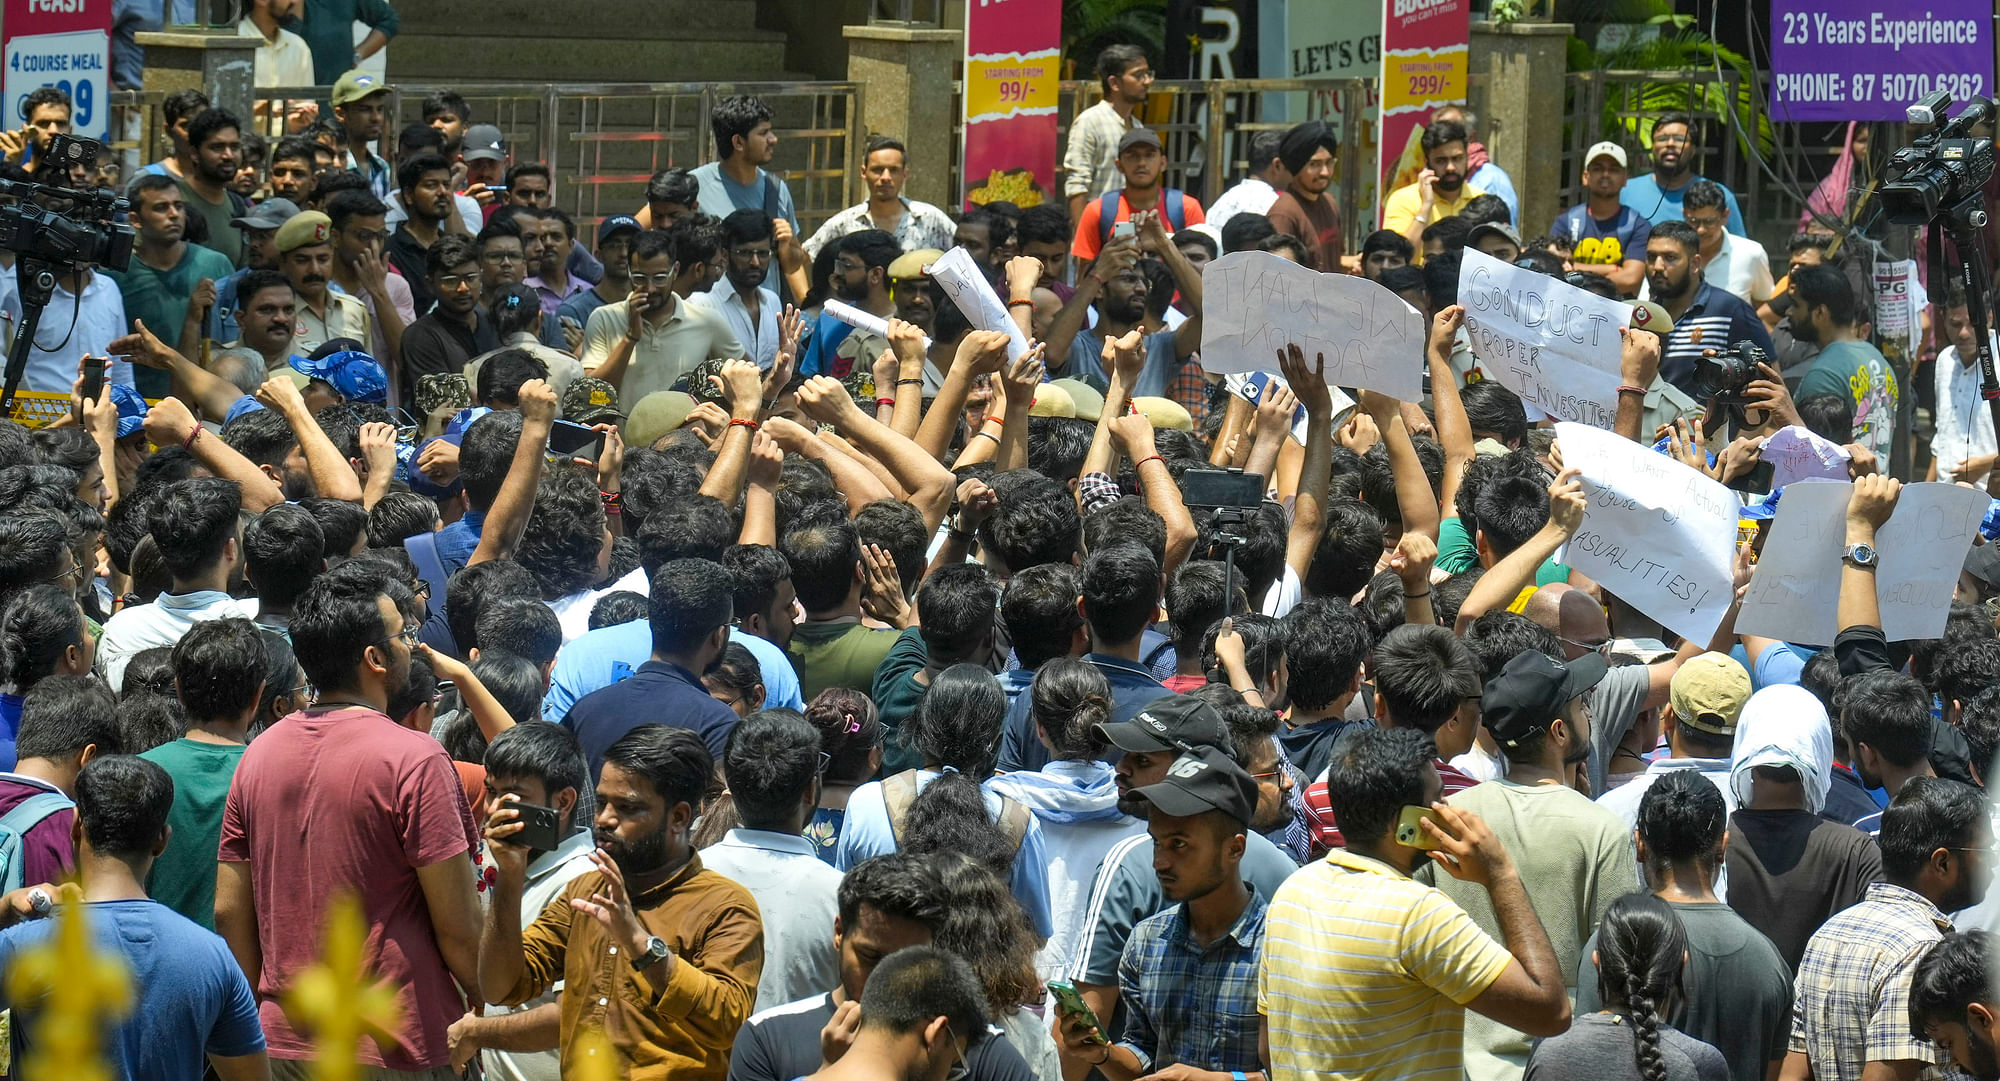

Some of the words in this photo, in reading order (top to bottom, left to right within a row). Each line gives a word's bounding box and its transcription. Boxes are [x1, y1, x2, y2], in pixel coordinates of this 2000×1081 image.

[1402, 14, 1416, 28] you
[1418, 7, 1438, 20] can't
[1783, 12, 1808, 44] 23
[1814, 12, 1865, 44] Years
[1870, 11, 1978, 51] Experience
[11, 51, 19, 72] 4
[23, 54, 68, 72] COURSE
[71, 53, 102, 70] MEAL
[1292, 39, 1352, 77] LET'S
[1399, 62, 1431, 73] STARTING
[1433, 61, 1453, 72] FROM
[984, 68, 1020, 79] STARTING
[1022, 67, 1044, 78] FROM
[1409, 75, 1451, 96] 299/-
[1000, 81, 1036, 102] 99/-
[1777, 73, 1846, 102] PHONE:
[1852, 74, 1875, 102] 87
[1882, 74, 1930, 102] 5070
[1879, 282, 1905, 294] PG
[1468, 266, 1609, 347] CONDUCT
[1467, 315, 1542, 374] PROPER
[1685, 477, 1728, 521] Actual
[1573, 512, 1710, 615] ASUALITIES!
